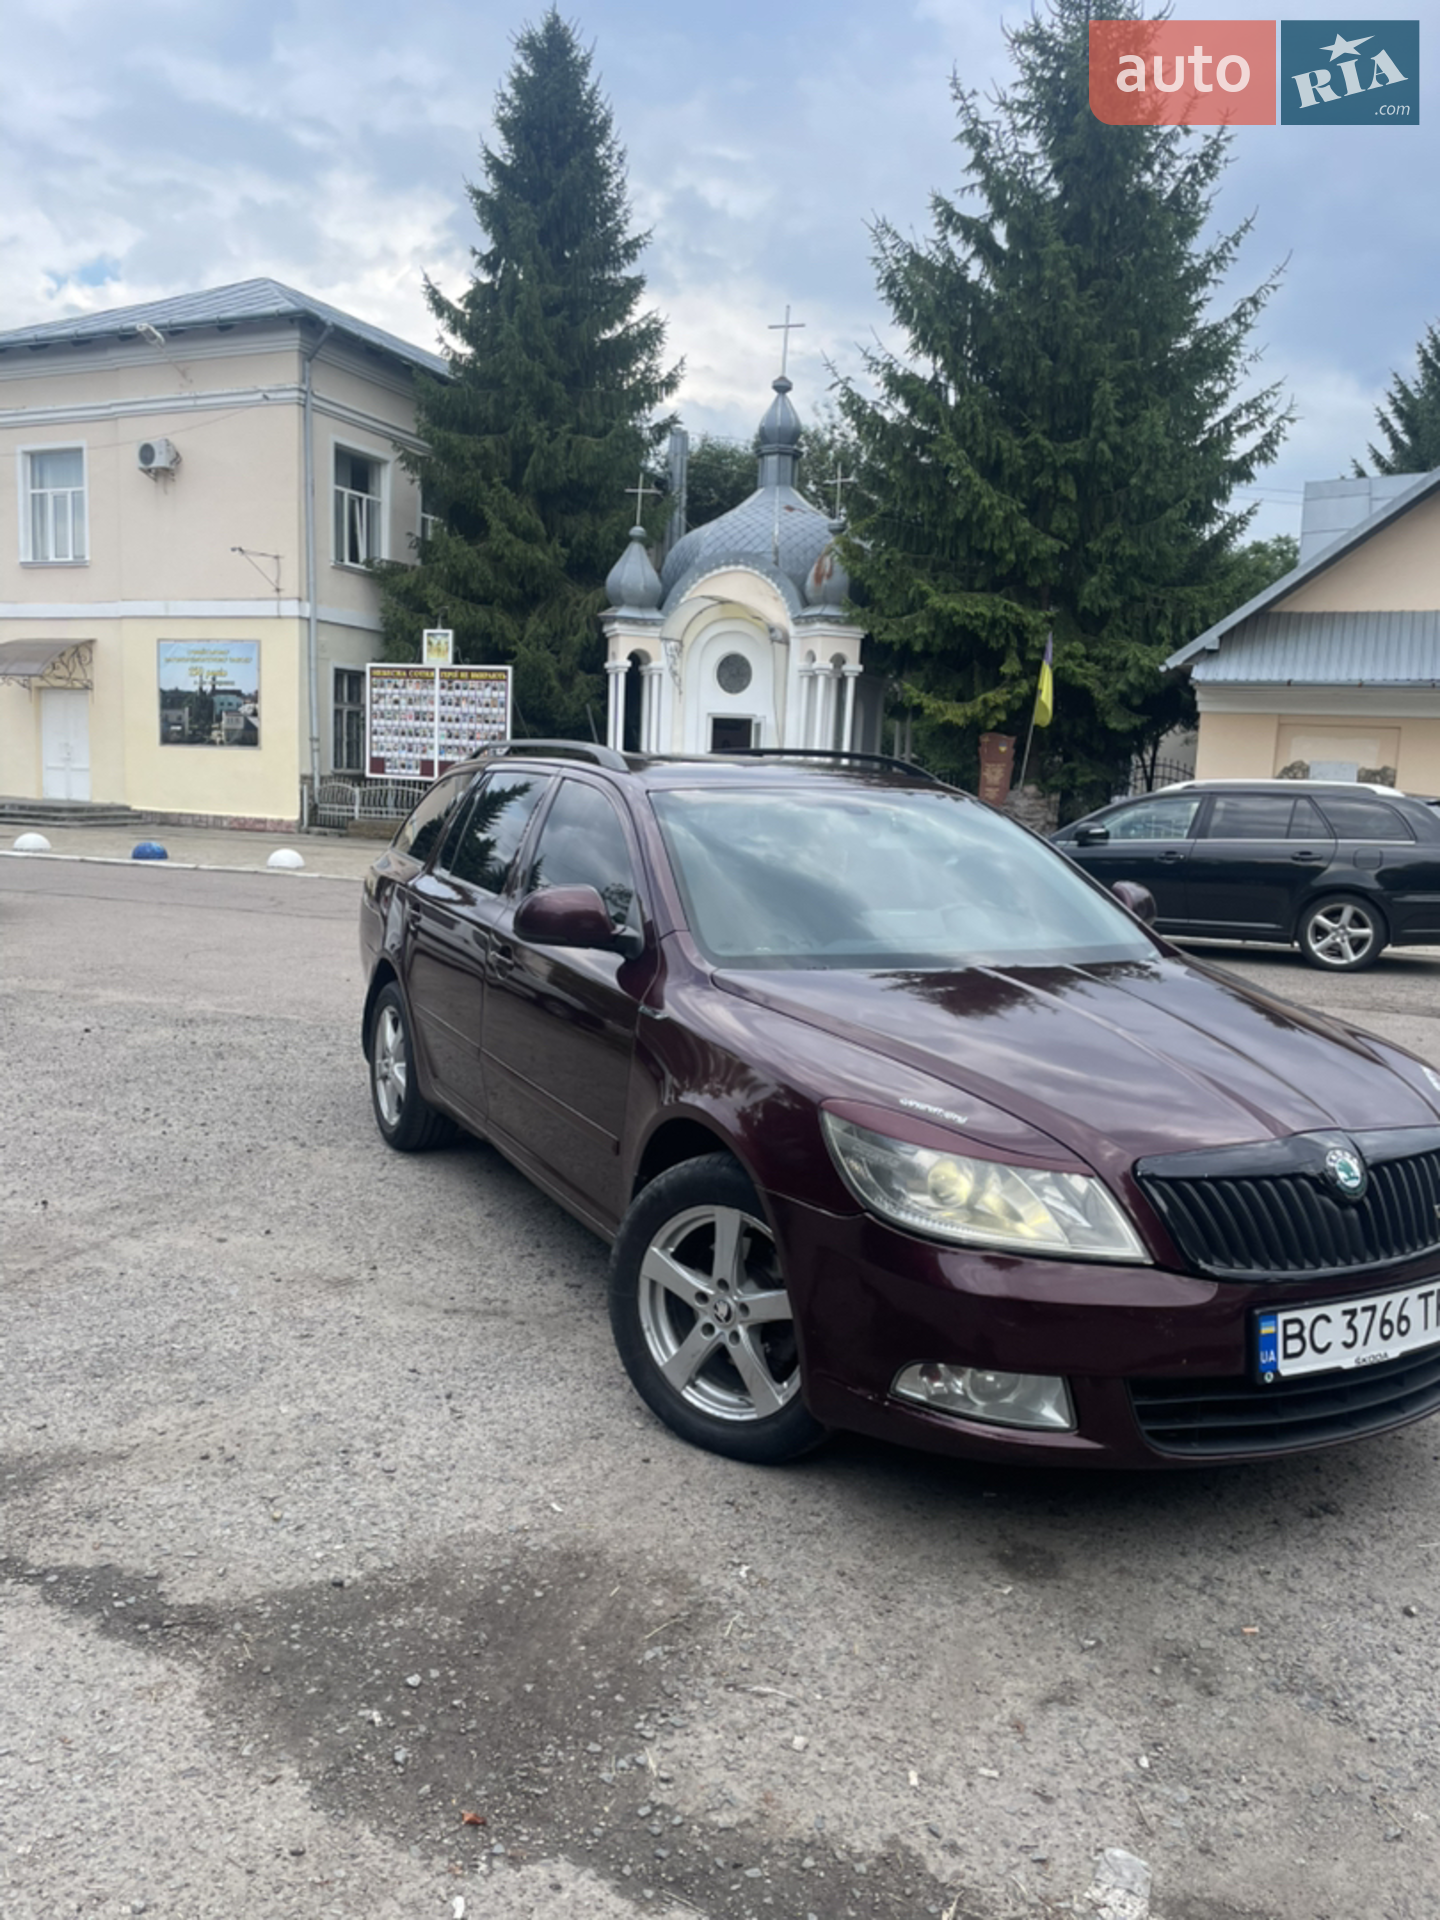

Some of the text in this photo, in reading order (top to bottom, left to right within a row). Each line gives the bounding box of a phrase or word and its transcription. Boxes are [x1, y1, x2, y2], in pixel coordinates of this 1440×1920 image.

[1282, 1313, 1333, 1360] BC
[1341, 1297, 1411, 1349] 3766
[1260, 1350, 1277, 1364] UA
